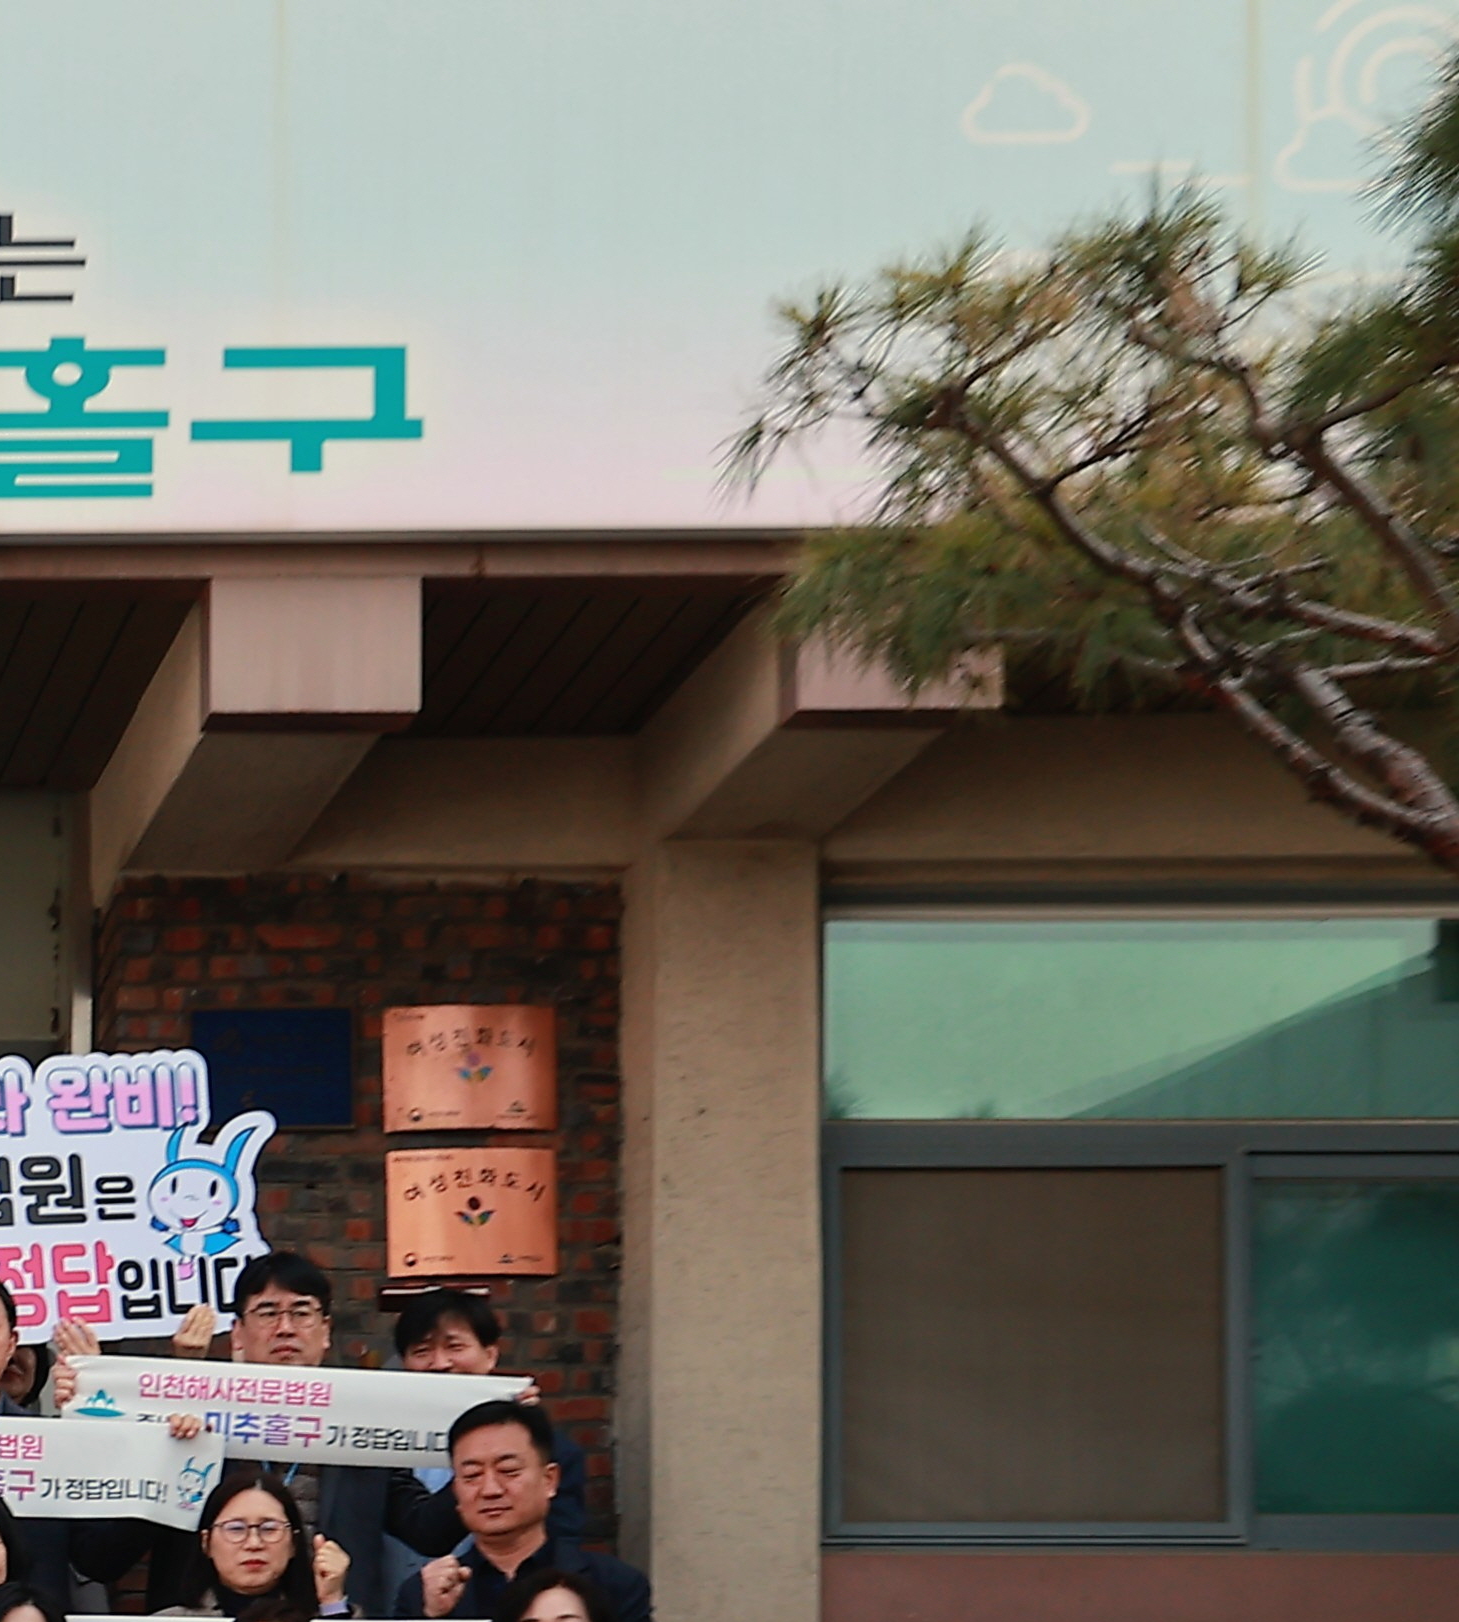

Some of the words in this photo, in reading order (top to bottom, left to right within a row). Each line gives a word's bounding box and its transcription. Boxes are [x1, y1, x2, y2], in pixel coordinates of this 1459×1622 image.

[45, 1067, 201, 1132] 완비!
[139, 1373, 331, 1408] 인천해사전문법원
[65, 1473, 166, 1507] 정답입니다!
